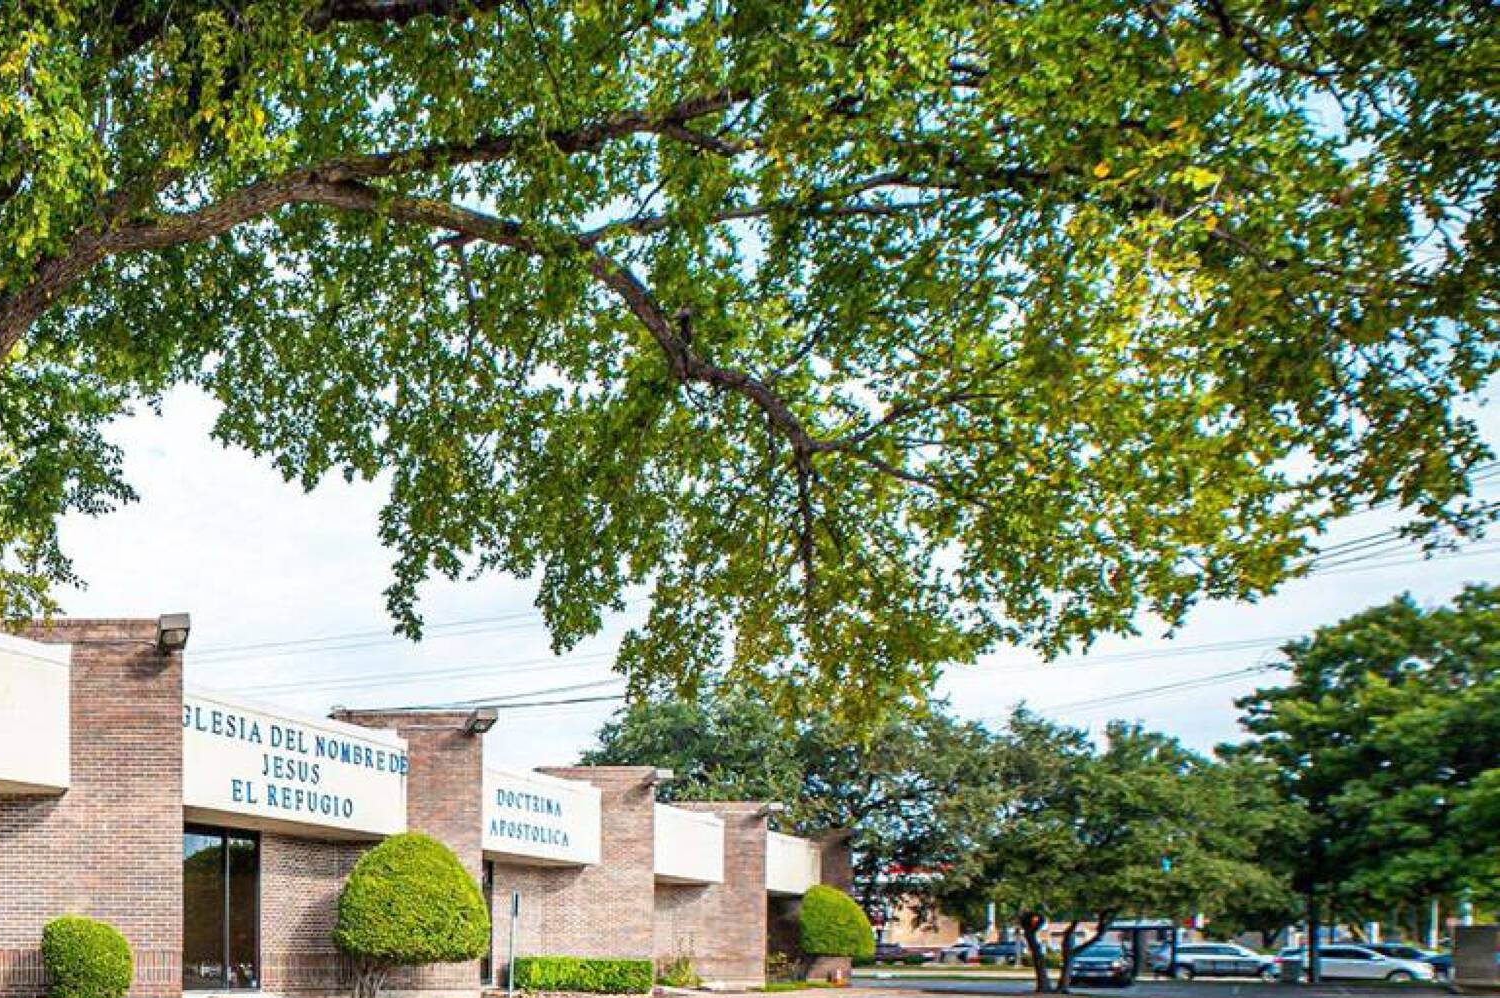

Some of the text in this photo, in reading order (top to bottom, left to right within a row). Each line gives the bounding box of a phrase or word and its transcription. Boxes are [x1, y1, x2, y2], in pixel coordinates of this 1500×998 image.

[182, 704, 263, 744] GLESIA
[269, 725, 309, 753] DEL
[262, 753, 321, 785] JESUS
[230, 778, 353, 819] EL REFUGIO
[490, 818, 569, 847] APOSTOLICA
